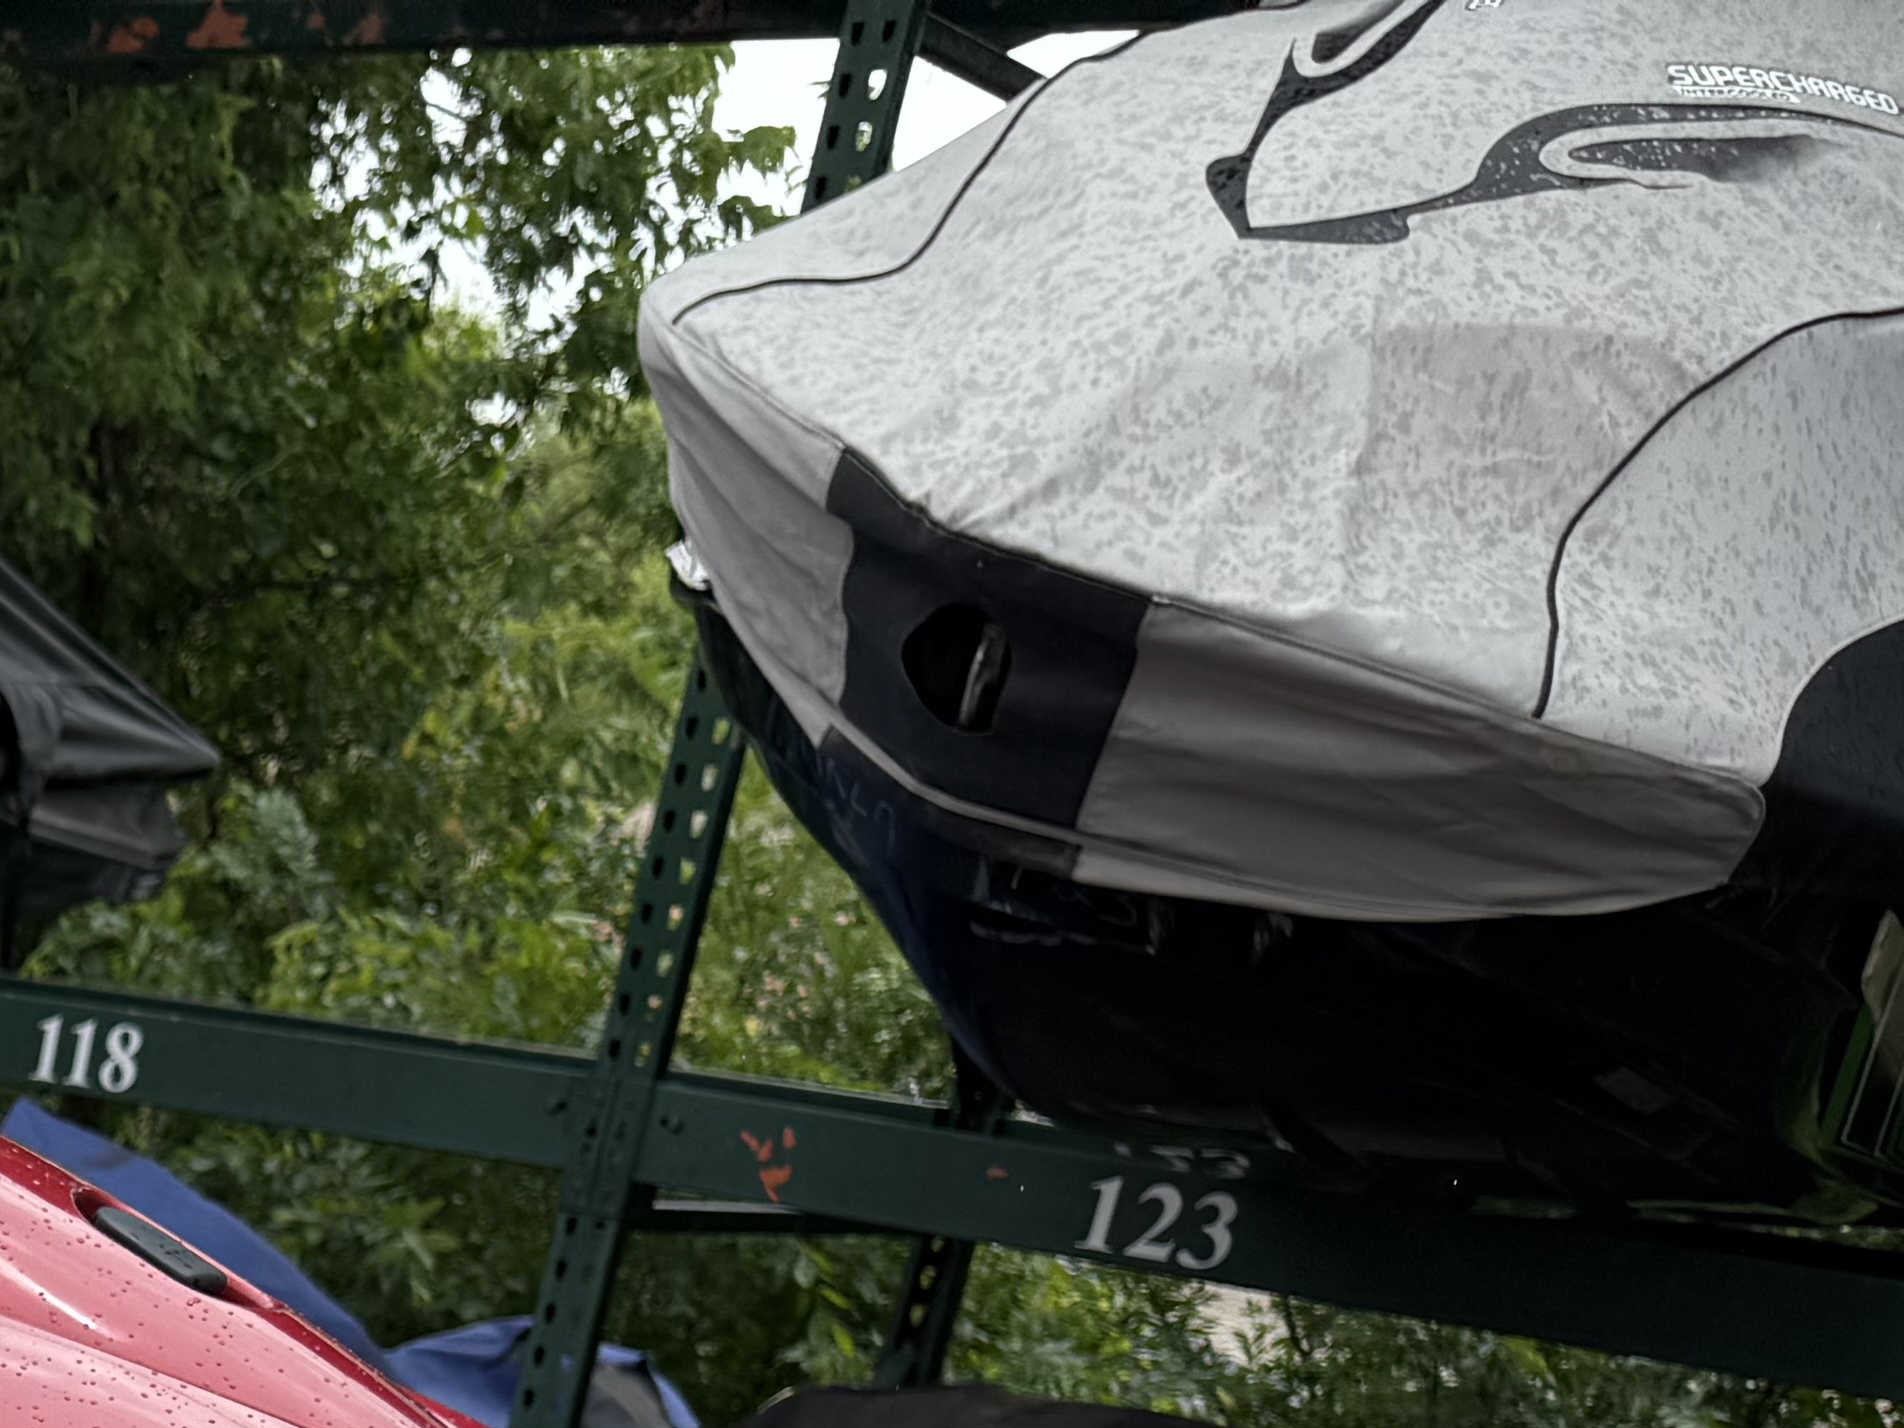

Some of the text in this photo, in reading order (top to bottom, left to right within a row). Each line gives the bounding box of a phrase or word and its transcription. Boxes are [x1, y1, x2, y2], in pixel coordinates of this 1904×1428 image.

[1667, 64, 1899, 115] SUPERCHARGED
[28, 1012, 145, 1093] 118
[1074, 1175, 1238, 1270] 123
